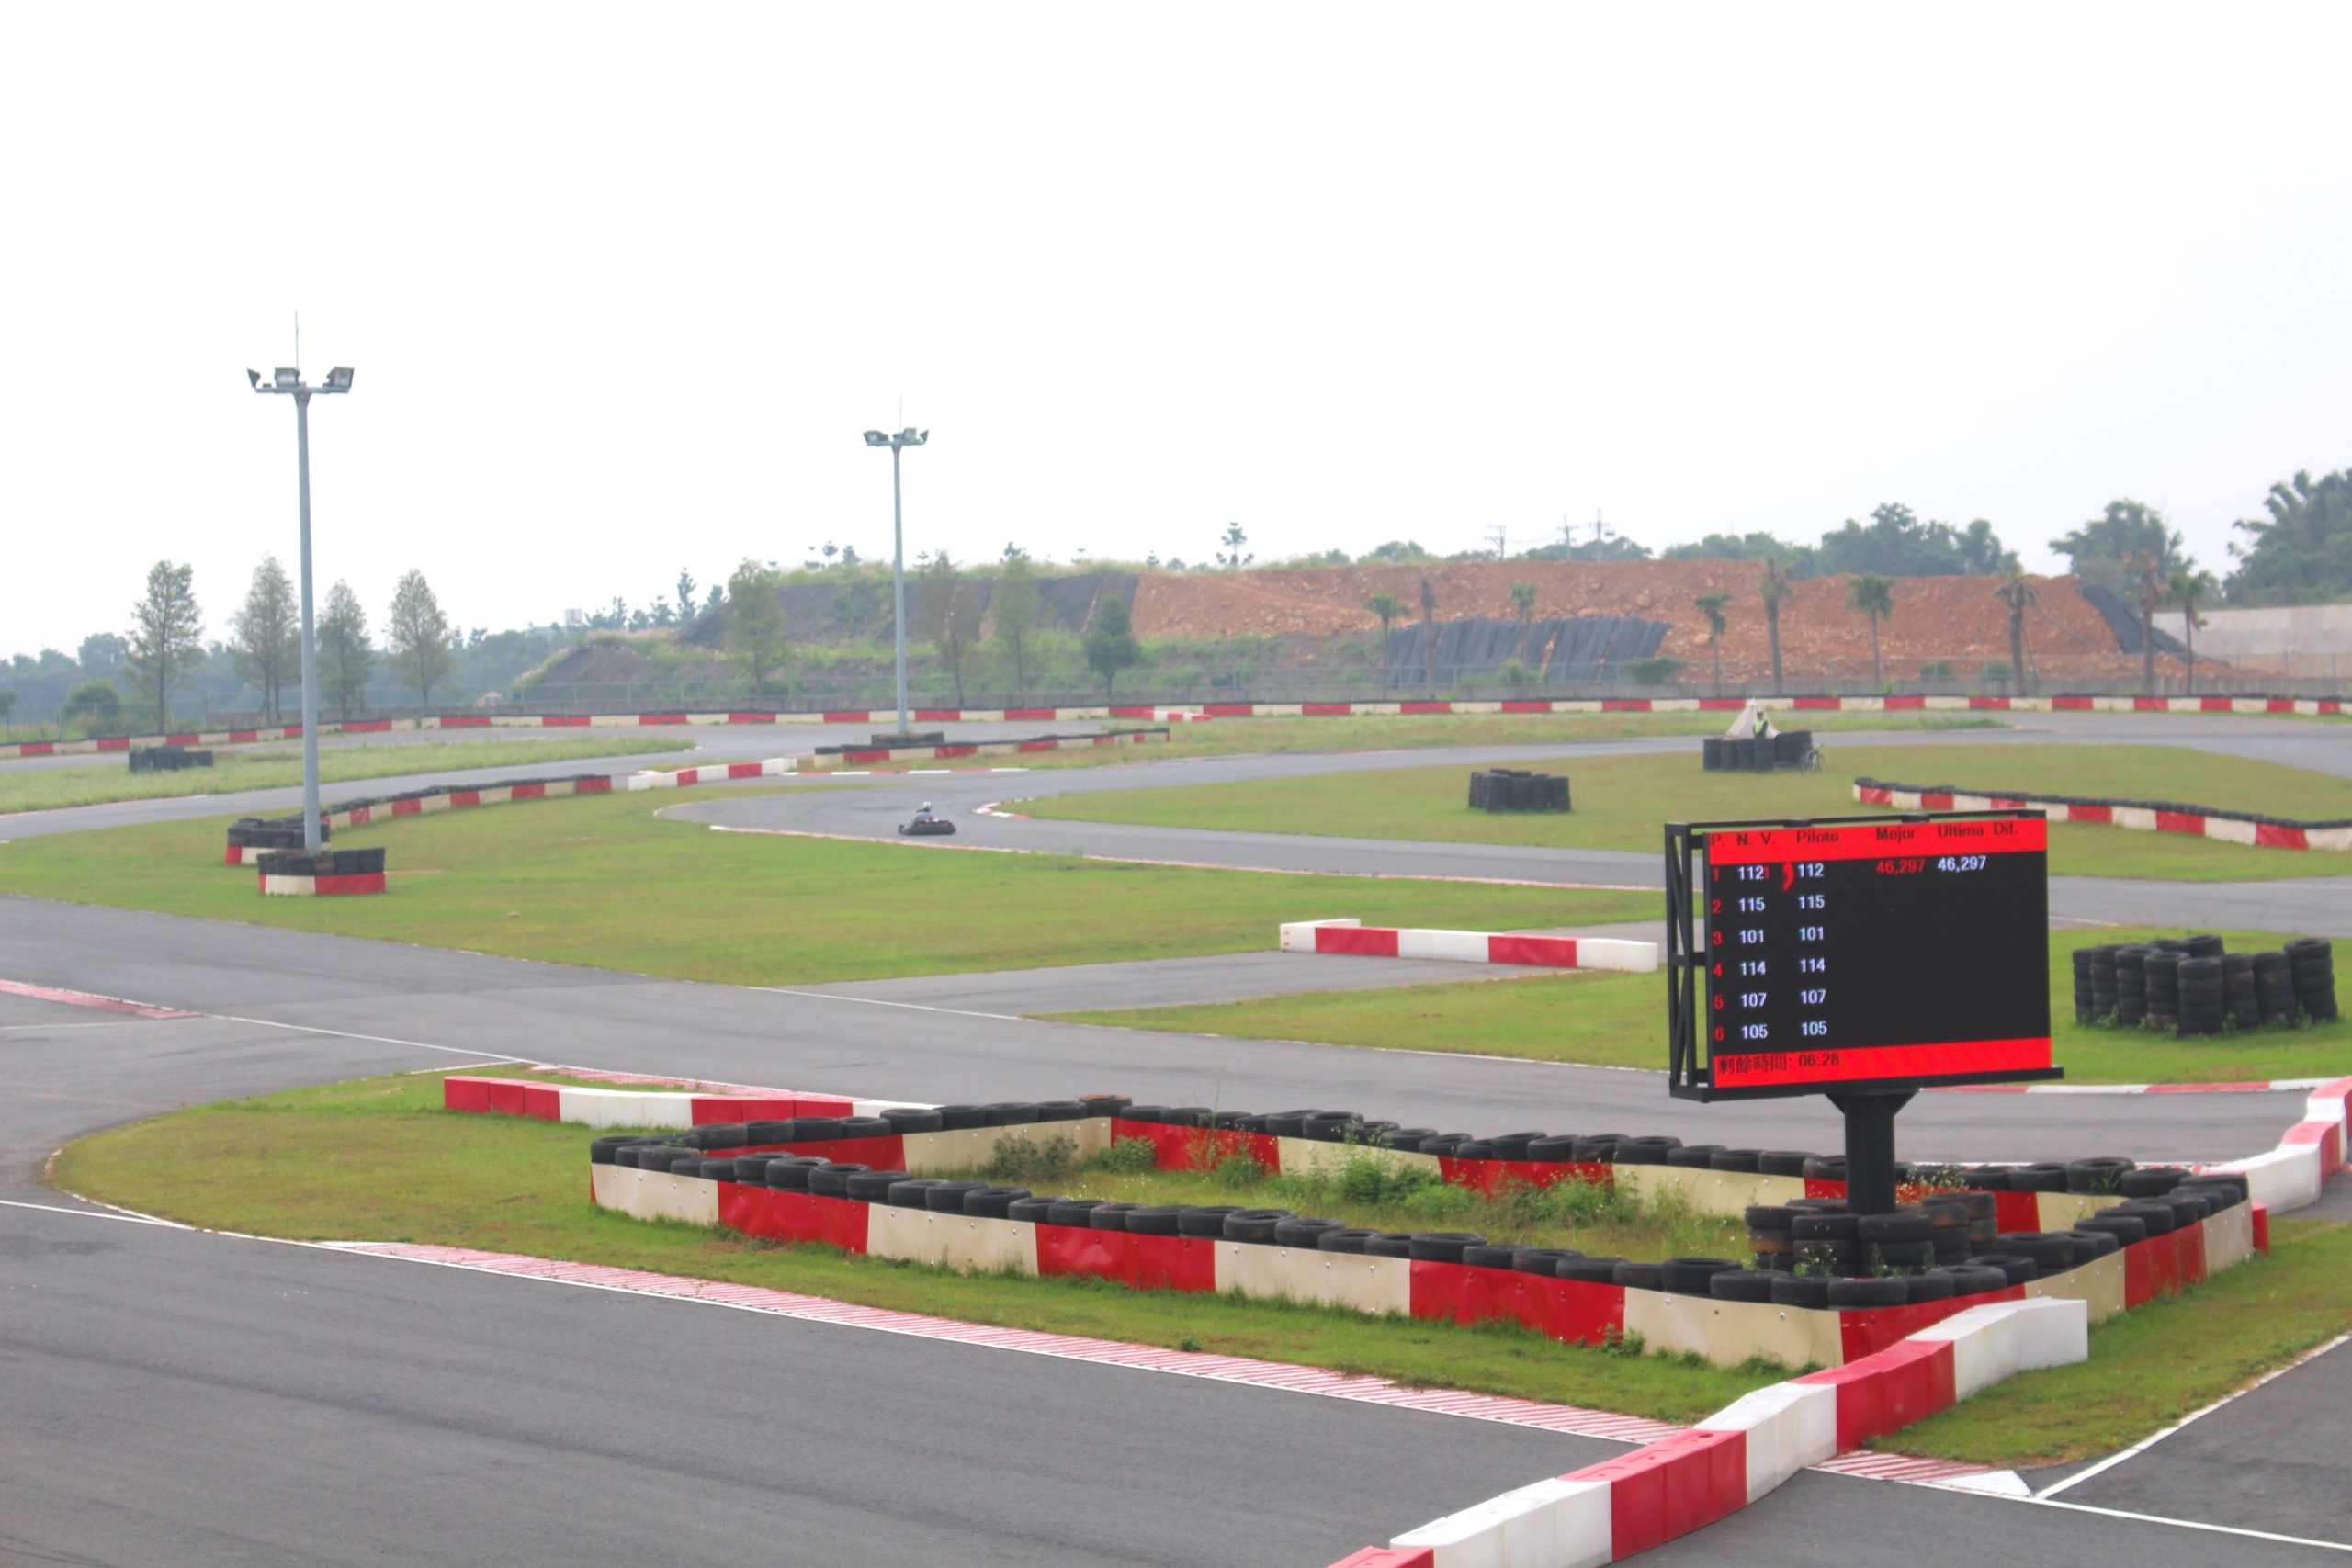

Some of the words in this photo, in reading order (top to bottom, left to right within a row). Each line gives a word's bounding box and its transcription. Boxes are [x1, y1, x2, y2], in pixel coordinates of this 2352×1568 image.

[1712, 835, 1726, 847] P.
[1737, 833, 1753, 846] N.
[1760, 832, 1776, 845] V.
[1796, 830, 1839, 843] Piloto
[1876, 826, 1916, 842] Mejor
[1993, 821, 2018, 835] Dif.
[1713, 867, 1721, 882] 1
[1738, 865, 1764, 881] 112
[1798, 863, 1825, 878] 112
[1876, 859, 1926, 874] 46,297
[1937, 855, 1987, 873] 46,297
[1712, 899, 1722, 914] 2
[1738, 897, 1766, 912] 115
[1798, 894, 1826, 909] 115
[1713, 931, 1723, 946] 3
[1739, 929, 1764, 944] 101
[1799, 926, 1824, 942] 101
[1713, 963, 1723, 976] 4
[1740, 961, 1767, 976] 114
[1800, 957, 1826, 973] 114
[1713, 995, 1724, 1010] 5
[1741, 992, 1767, 1008] 107
[1801, 988, 1826, 1004] 107
[1714, 1026, 1725, 1042] 6
[1741, 1023, 1769, 1040] 105
[1801, 1021, 1827, 1036] 105
[1798, 1053, 1839, 1067] 06:28
